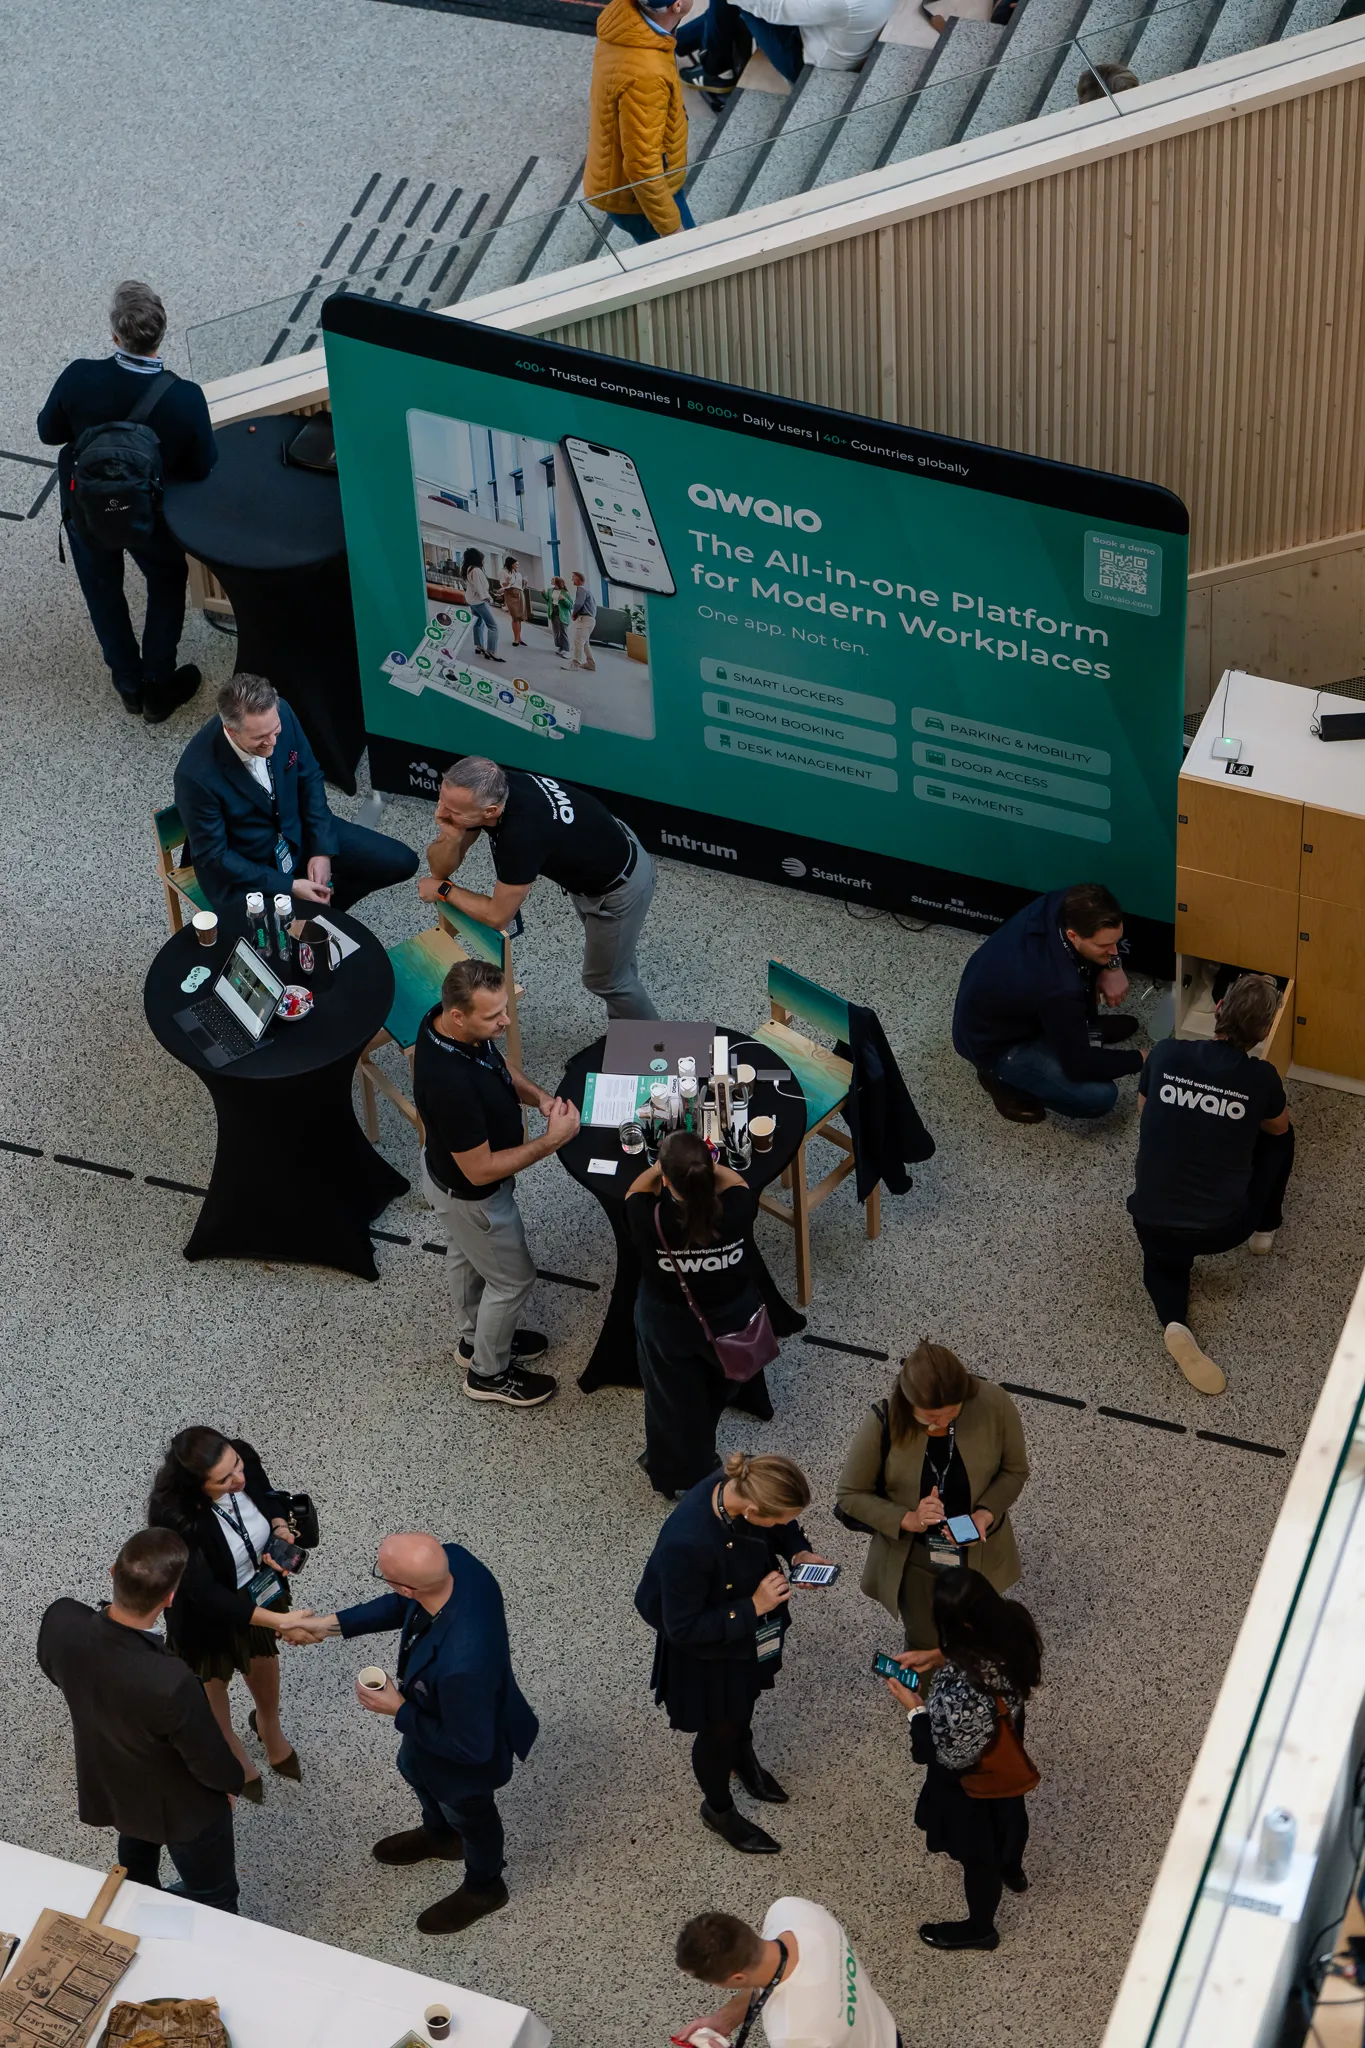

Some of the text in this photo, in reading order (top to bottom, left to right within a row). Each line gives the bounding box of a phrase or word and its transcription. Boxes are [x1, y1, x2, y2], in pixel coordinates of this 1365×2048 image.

[514, 359, 546, 374] 400+
[549, 367, 597, 387] Trusted
[600, 379, 670, 405] companies
[687, 400, 704, 412] 80
[706, 404, 739, 420] 000+
[743, 412, 775, 430] Daily
[778, 424, 813, 439] users
[823, 433, 848, 447] 40+
[850, 439, 914, 463] Countries
[917, 454, 970, 477] globally
[687, 483, 822, 533] awaio
[1092, 536, 1117, 547] Book
[1127, 544, 1156, 555] demo
[688, 530, 1109, 647] The All-in-one Platform
[1103, 593, 1153, 609] awaio.com
[691, 564, 1112, 680] for Modern Workplaces
[698, 605, 870, 657] One app. Not ten.
[733, 672, 845, 706] SMART LOCKERS
[735, 706, 845, 740] ROOM BOOKING
[737, 740, 872, 780] DESK MANAGEMENT
[950, 722, 1093, 765] PARKING & MOBILITY
[952, 757, 1049, 789] DOOR ACCESS
[952, 791, 1024, 817] PAYMENTS
[660, 829, 738, 860] intrum
[811, 867, 872, 890] Statkraft
[910, 895, 1005, 923] Stena Fastigheter
[1159, 1084, 1246, 1120] awaio
[1175, 1076, 1193, 1086] hybrid
[1194, 1082, 1224, 1093] workplace
[1224, 1089, 1249, 1101] platform
[658, 1248, 744, 1273] awaio
